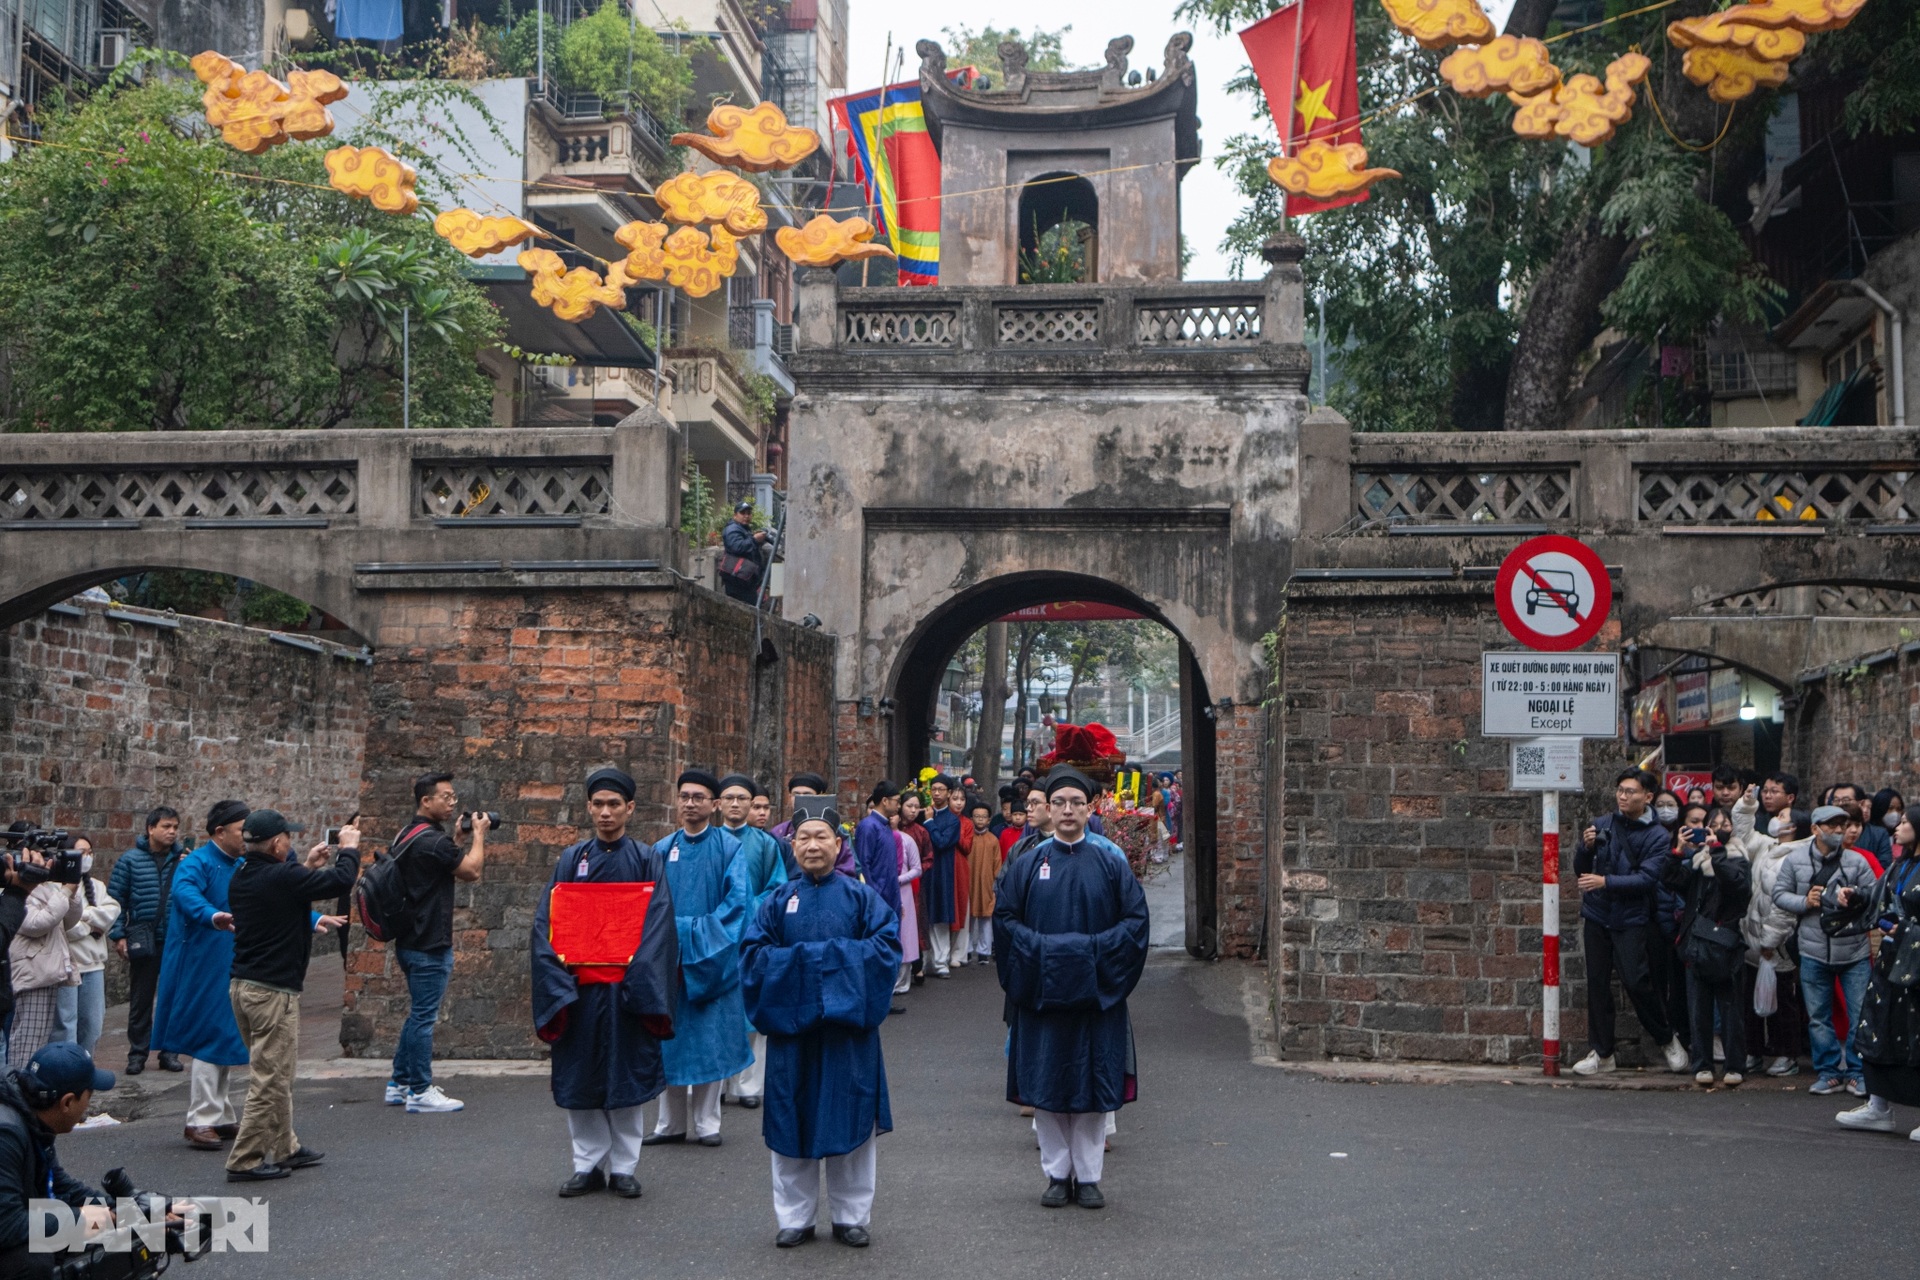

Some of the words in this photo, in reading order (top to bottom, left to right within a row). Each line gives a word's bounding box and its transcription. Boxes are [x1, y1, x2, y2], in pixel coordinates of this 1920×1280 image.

[1490, 662, 1500, 673] XE
[1502, 659, 1521, 673] QUÉT
[1522, 659, 1549, 673] ĐƯỜNG
[1550, 662, 1571, 675] ĐƯỢC
[1573, 663, 1592, 675] HOẠT
[1594, 660, 1615, 676] ĐỘNG
[1497, 678, 1508, 691] TỪ
[1563, 679, 1583, 692] HÀNG
[1585, 679, 1606, 692] NGÀY
[1528, 699, 1560, 715] NGOẠI
[1563, 697, 1575, 715] LỆ
[1531, 716, 1572, 731] Except
